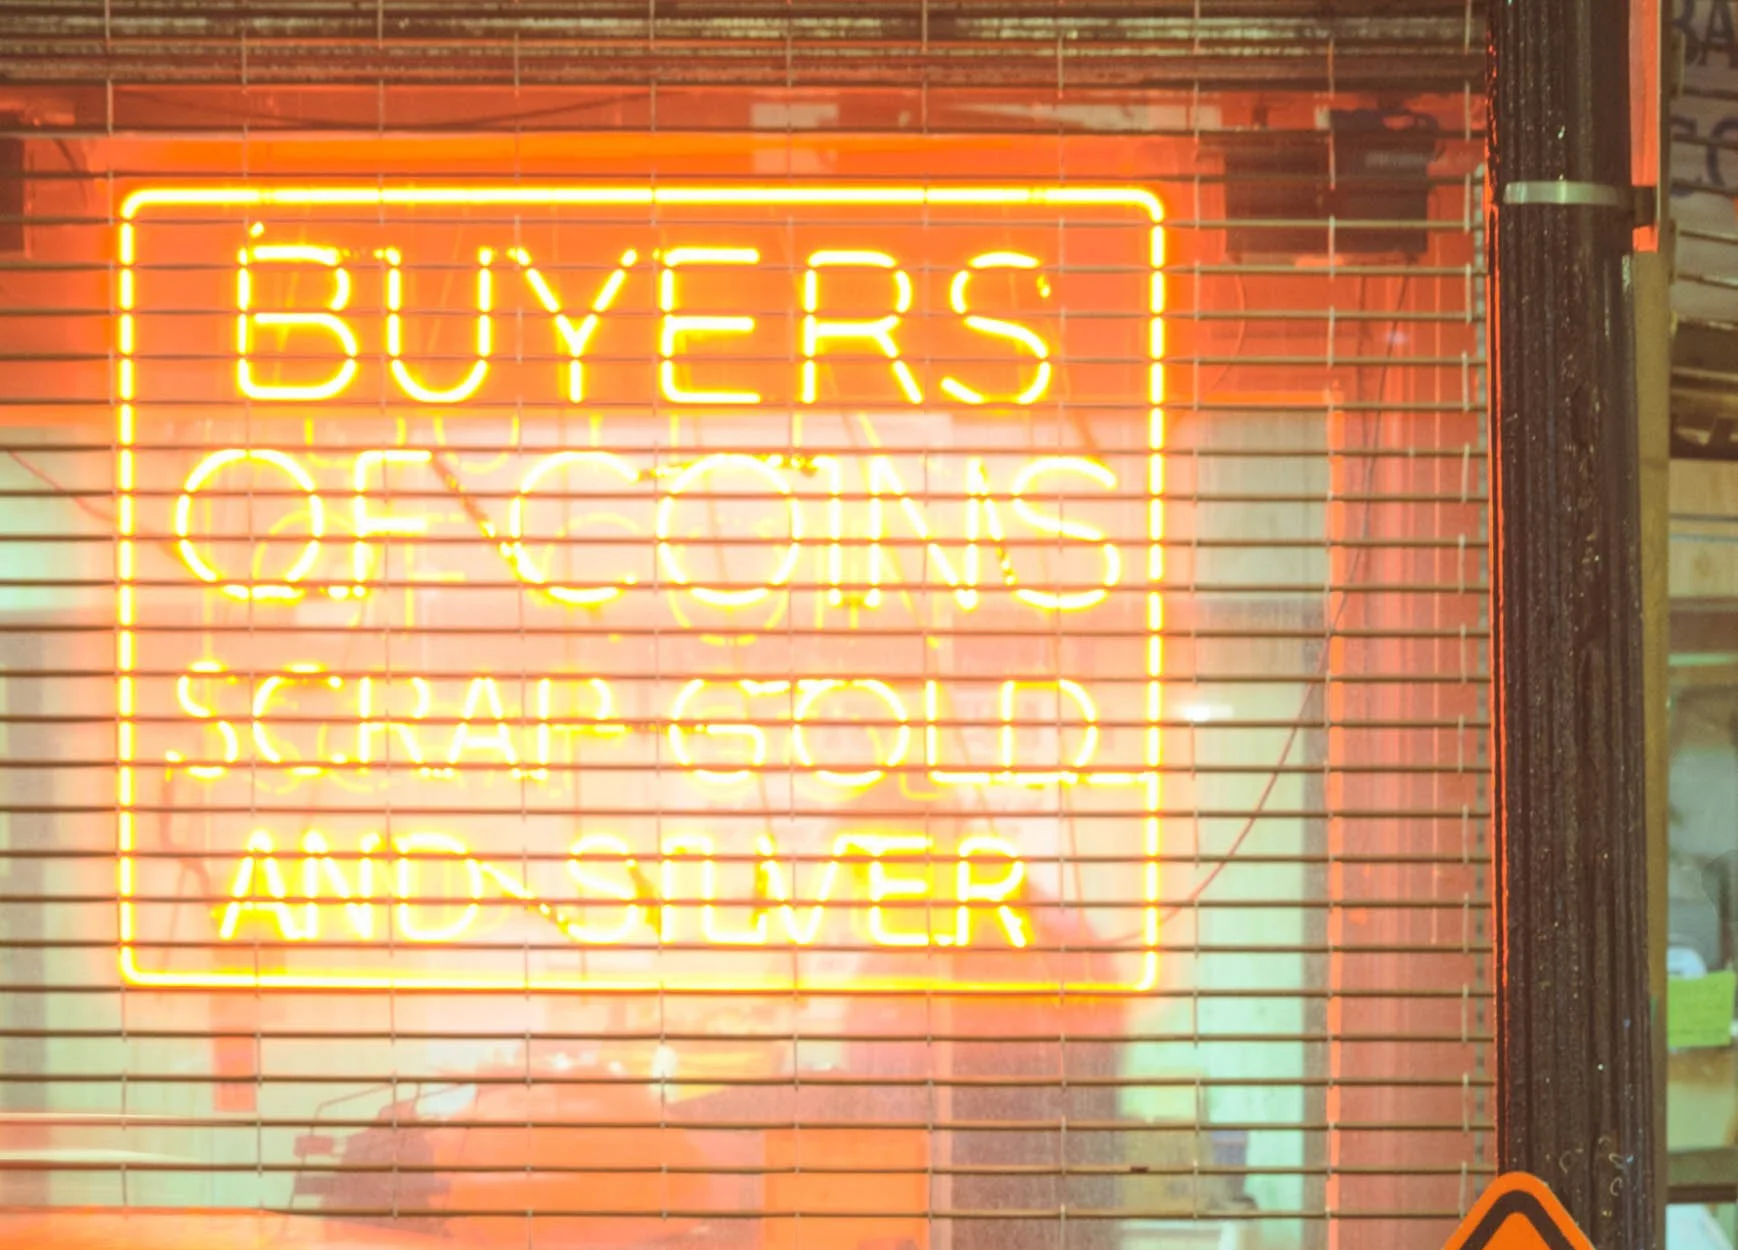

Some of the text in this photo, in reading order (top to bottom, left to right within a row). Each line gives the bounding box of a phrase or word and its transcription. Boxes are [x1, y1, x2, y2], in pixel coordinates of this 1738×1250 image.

[237, 244, 1053, 404] BUYERS
[174, 447, 1122, 611] OF COINS
[165, 660, 1100, 788] SCRAP GOLD
[216, 830, 1030, 948] AND SILVER
